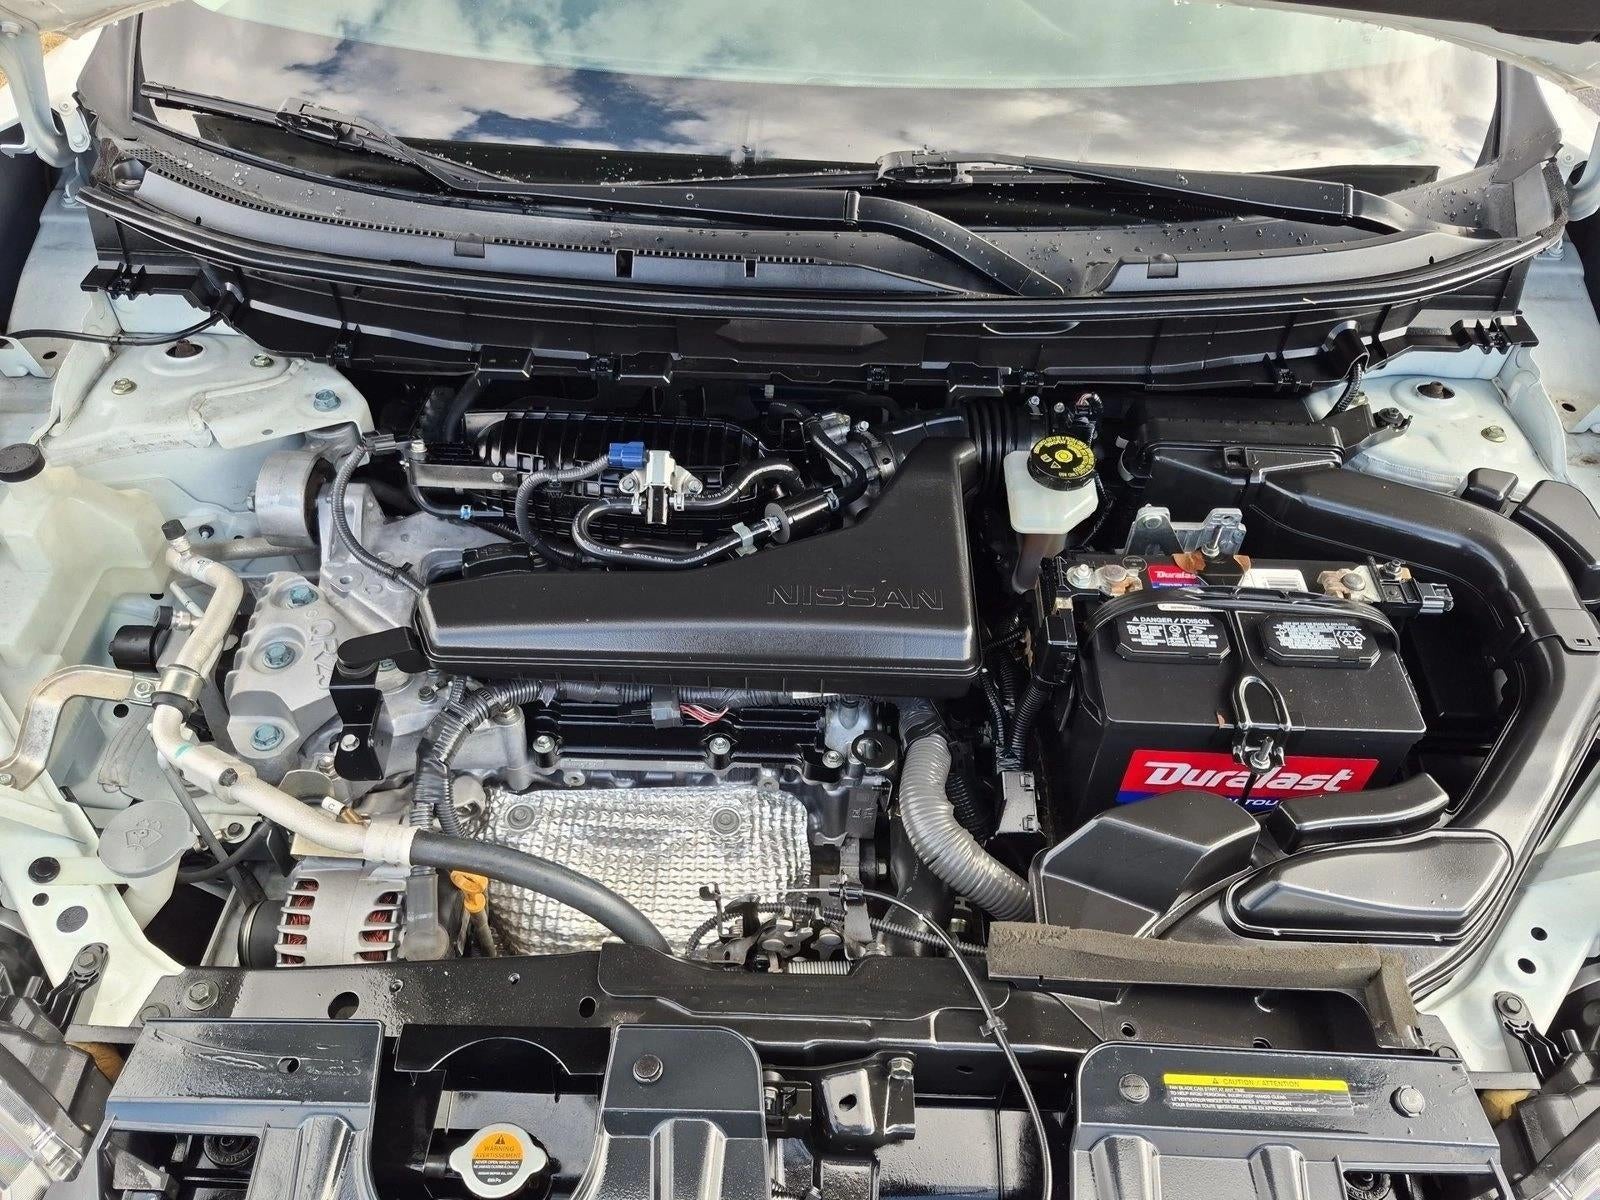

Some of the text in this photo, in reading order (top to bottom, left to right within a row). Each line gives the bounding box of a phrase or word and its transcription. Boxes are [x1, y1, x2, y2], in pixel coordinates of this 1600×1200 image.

[1154, 570, 1197, 579] Duralas
[767, 584, 944, 611] NISSAN
[1139, 616, 1173, 624] DANGER
[1144, 761, 1355, 792] Duralast
[1223, 1078, 1255, 1086] CAUTION
[1261, 1080, 1300, 1088] ATTENTION
